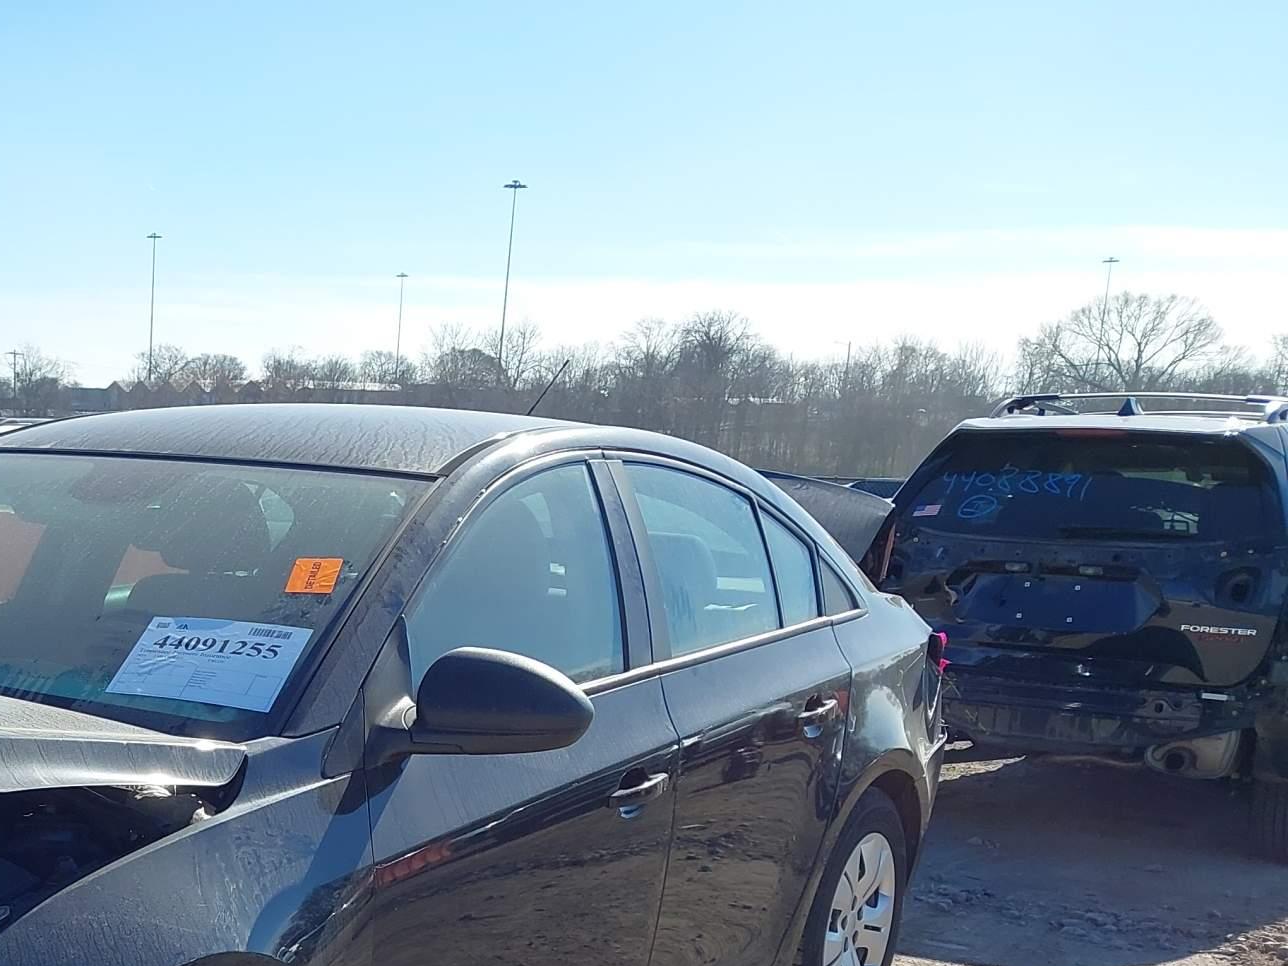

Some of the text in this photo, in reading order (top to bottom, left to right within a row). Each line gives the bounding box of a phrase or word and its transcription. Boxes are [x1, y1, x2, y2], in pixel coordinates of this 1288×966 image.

[304, 561, 322, 590] DETAILED
[1180, 624, 1257, 636] FORESTER
[153, 634, 283, 660] 44091255
